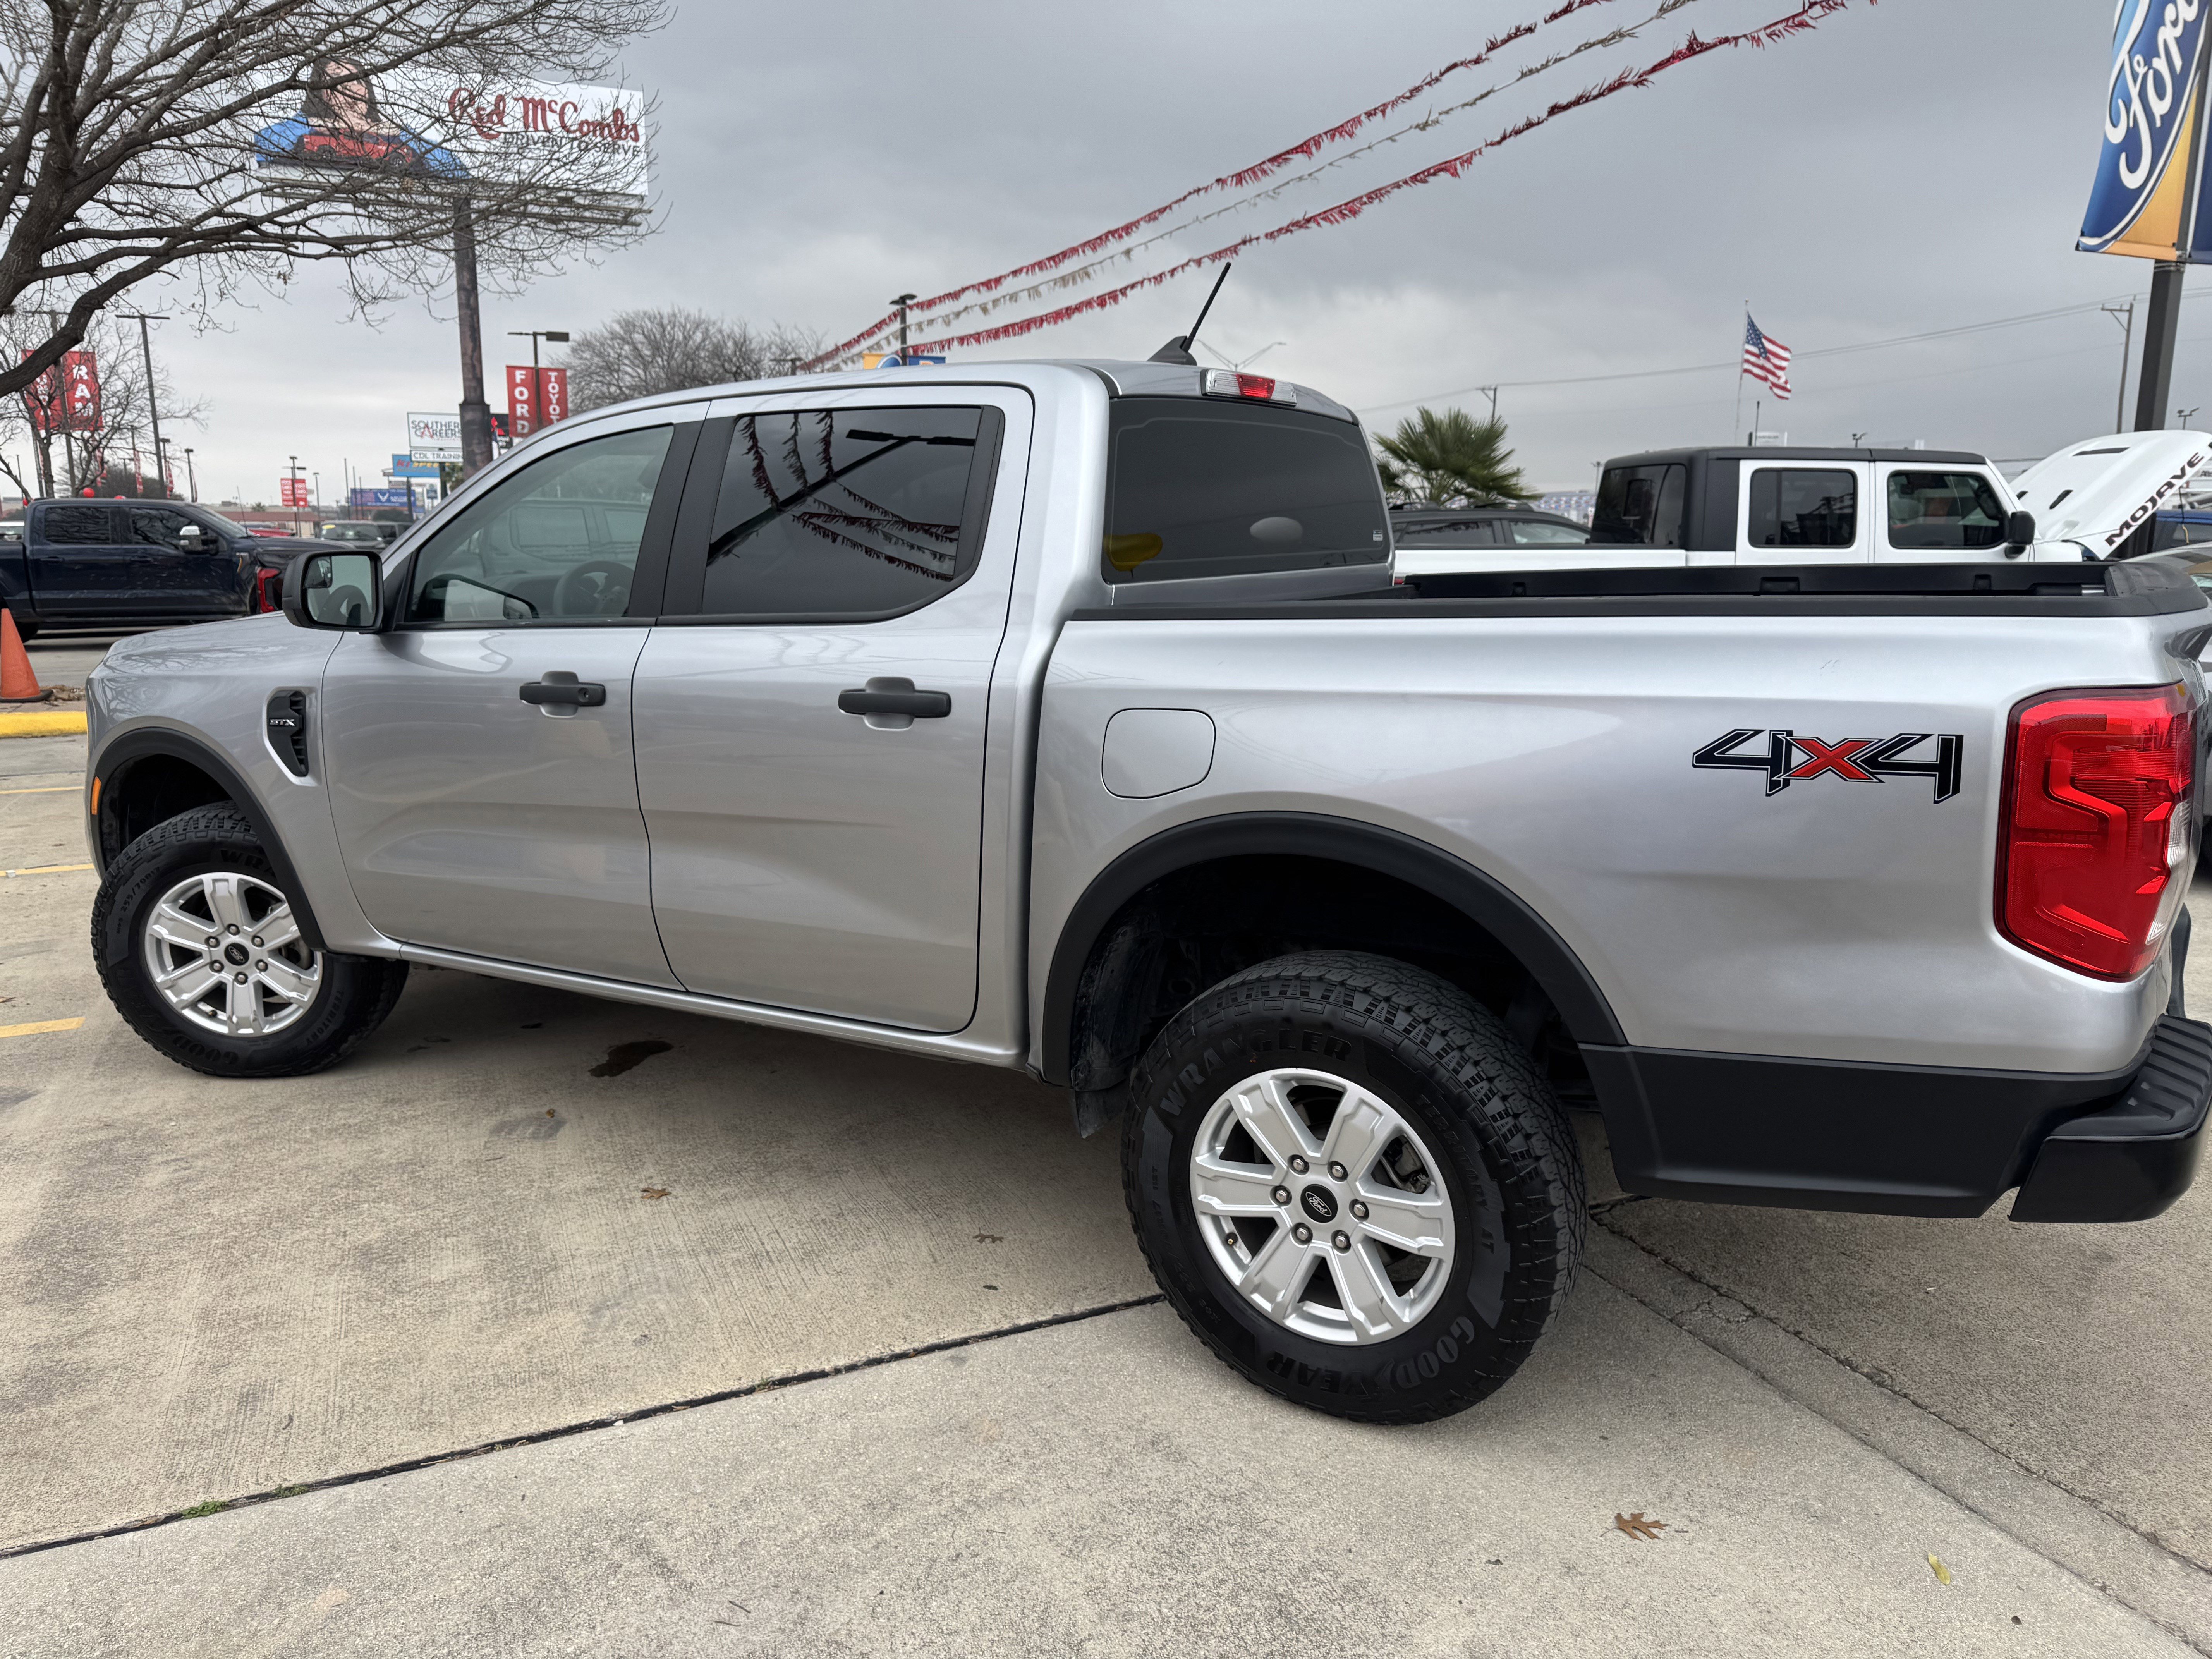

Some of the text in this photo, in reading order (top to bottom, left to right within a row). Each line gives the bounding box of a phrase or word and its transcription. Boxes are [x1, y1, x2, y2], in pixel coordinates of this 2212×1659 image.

[448, 87, 640, 142] Red McCombs
[72, 364, 94, 417] RAM
[514, 369, 530, 434] FORD
[2105, 452, 2205, 547] MOJAVE
[1160, 1028, 1352, 1116] WRANGLER
[1416, 1094, 1489, 1212] TERRITORY
[1309, 1196, 1328, 1213] Ford
